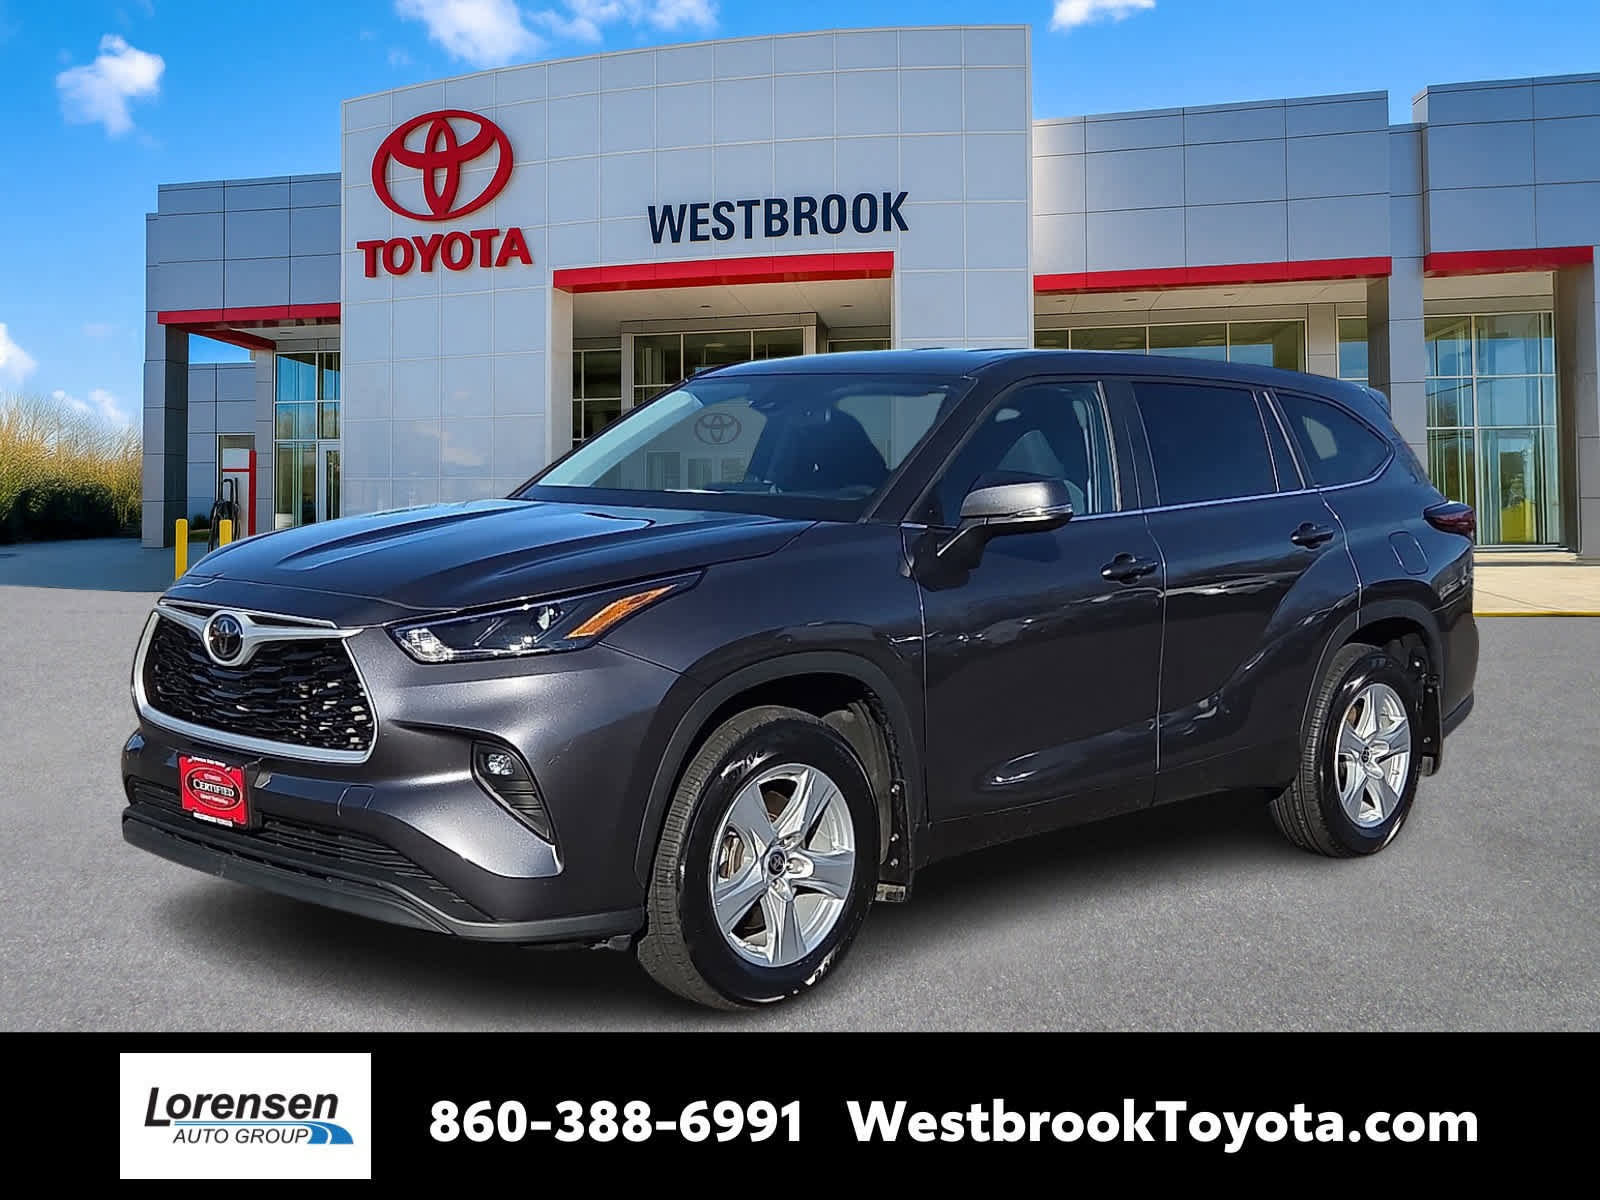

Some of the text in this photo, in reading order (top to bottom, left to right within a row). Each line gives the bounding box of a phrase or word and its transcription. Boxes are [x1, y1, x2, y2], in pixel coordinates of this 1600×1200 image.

[648, 192, 909, 244] WESTBROOK
[357, 228, 532, 278] TOYOTA
[193, 779, 235, 797] CERTIFIED
